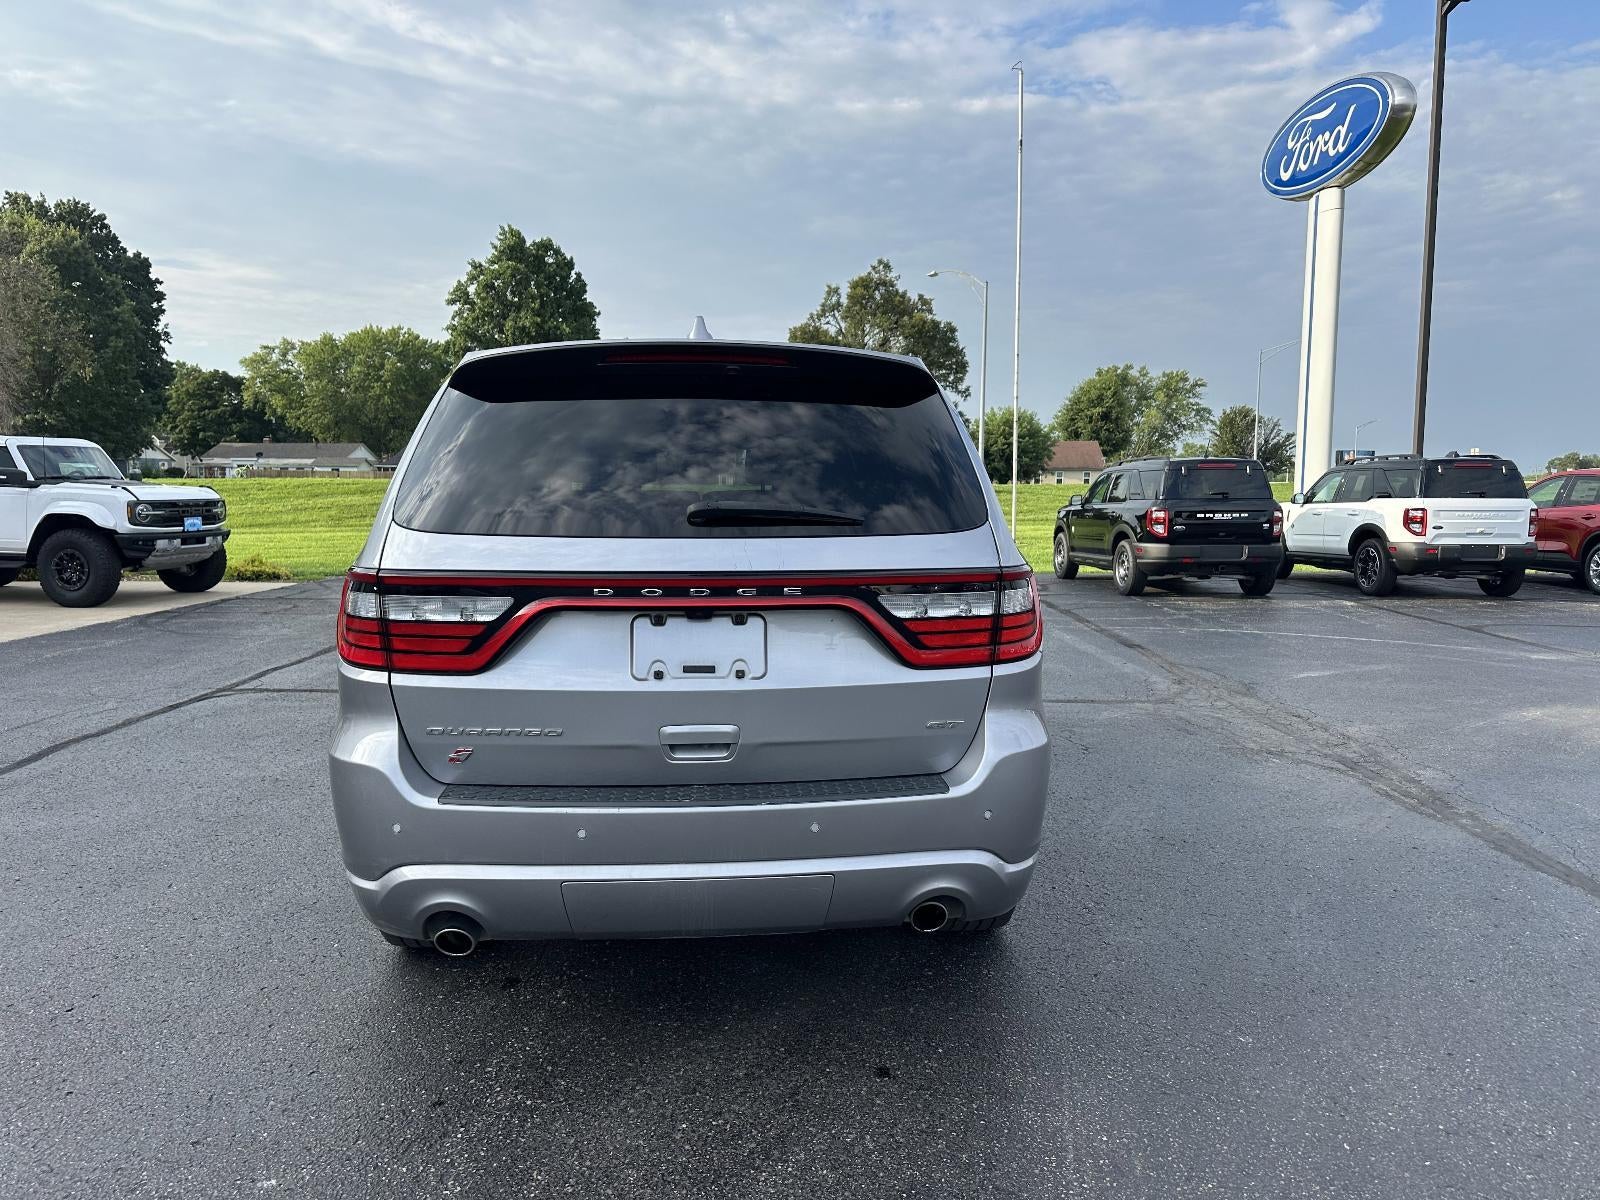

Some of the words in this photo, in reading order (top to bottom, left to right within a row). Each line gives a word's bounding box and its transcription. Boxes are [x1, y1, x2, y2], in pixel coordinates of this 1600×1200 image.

[1279, 102, 1357, 181] Ford
[593, 587, 802, 596] DODGE
[925, 720, 965, 729] GT
[425, 727, 564, 737] DURANGO
